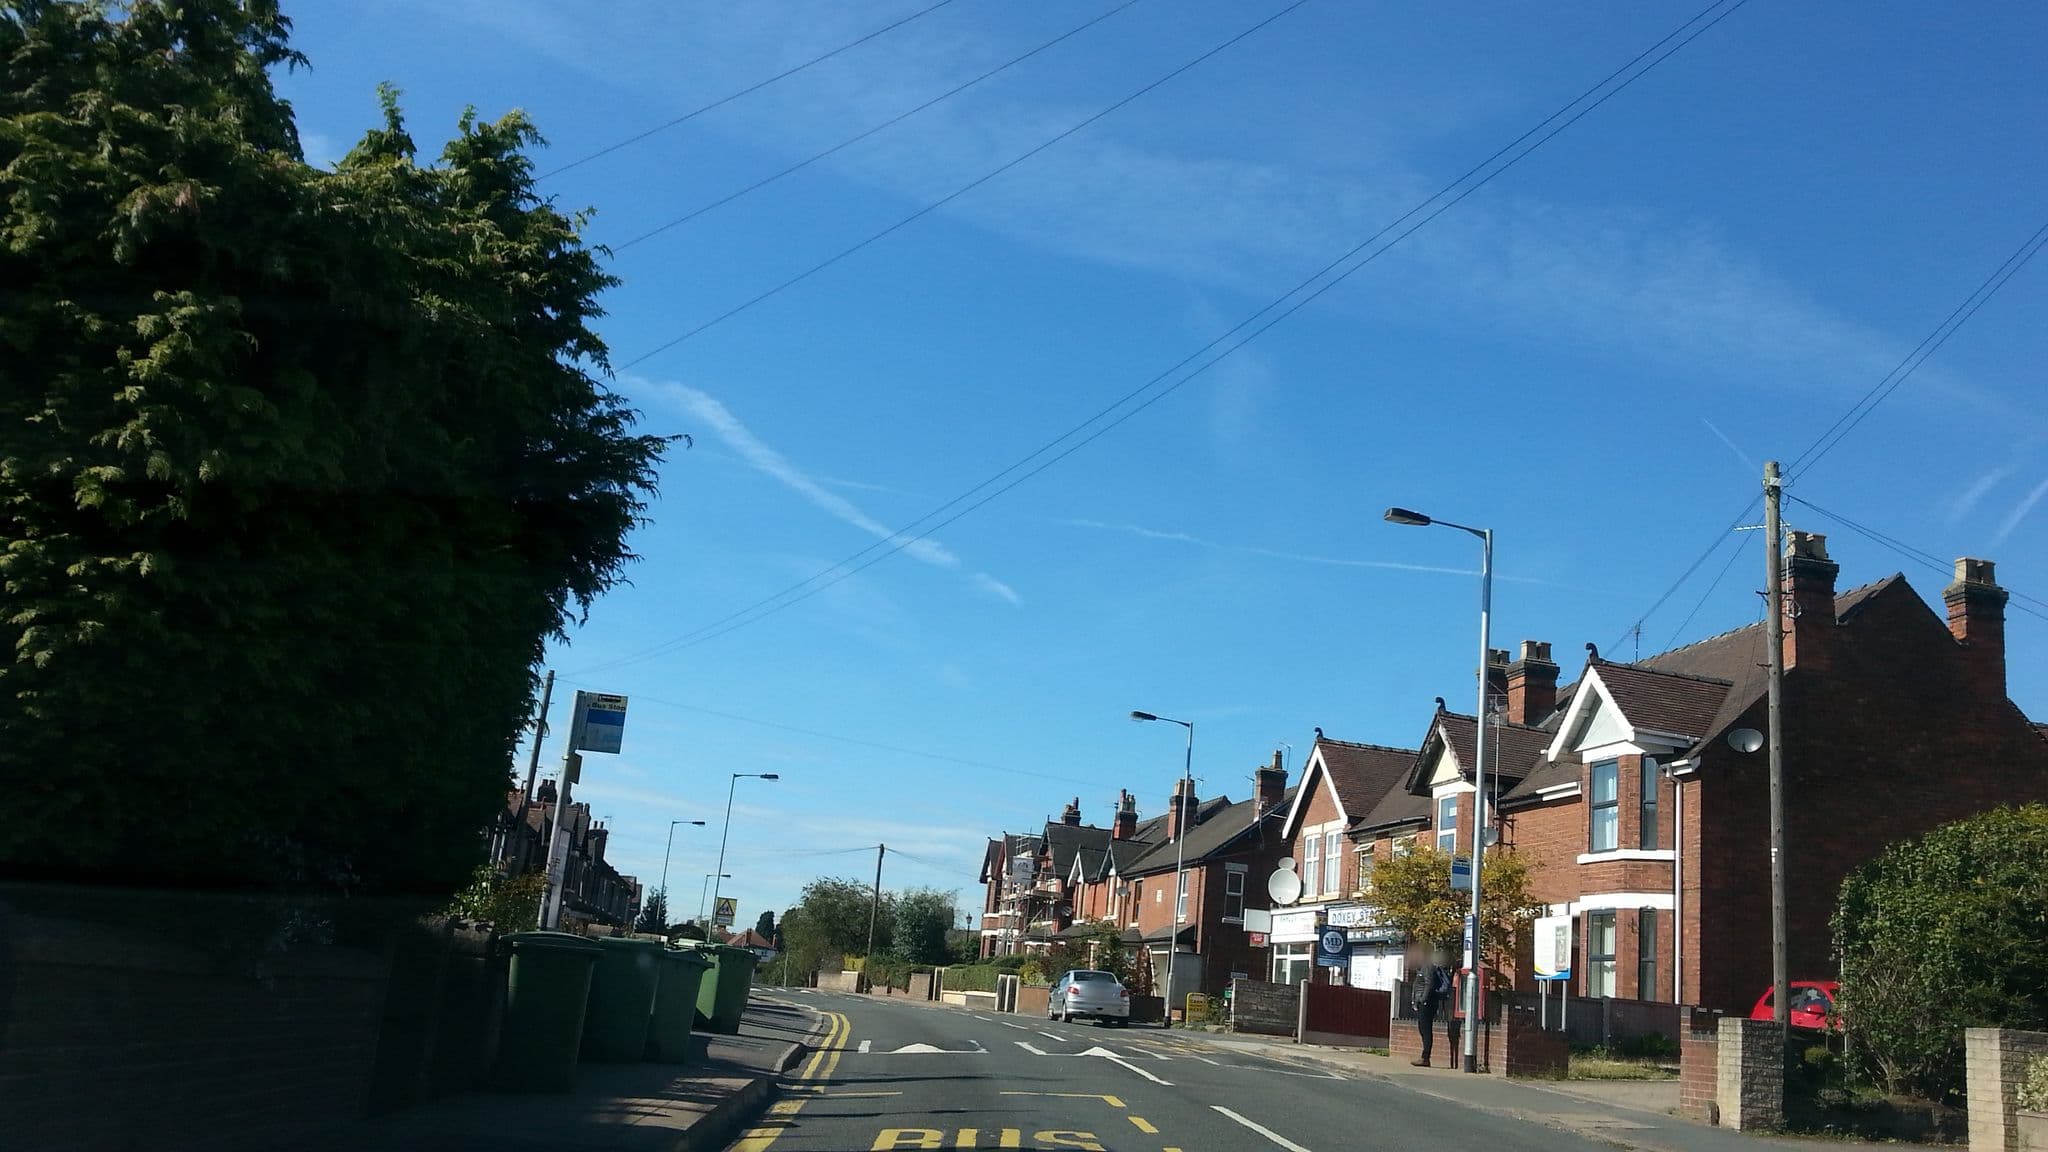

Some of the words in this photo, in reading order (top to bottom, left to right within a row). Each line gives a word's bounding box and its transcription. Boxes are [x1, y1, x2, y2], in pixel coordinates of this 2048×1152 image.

[608, 703, 625, 711] Stop
[1332, 911, 1356, 924] DOXEY
[1325, 937, 1342, 946] MD
[870, 1128, 1107, 1151] BUS
